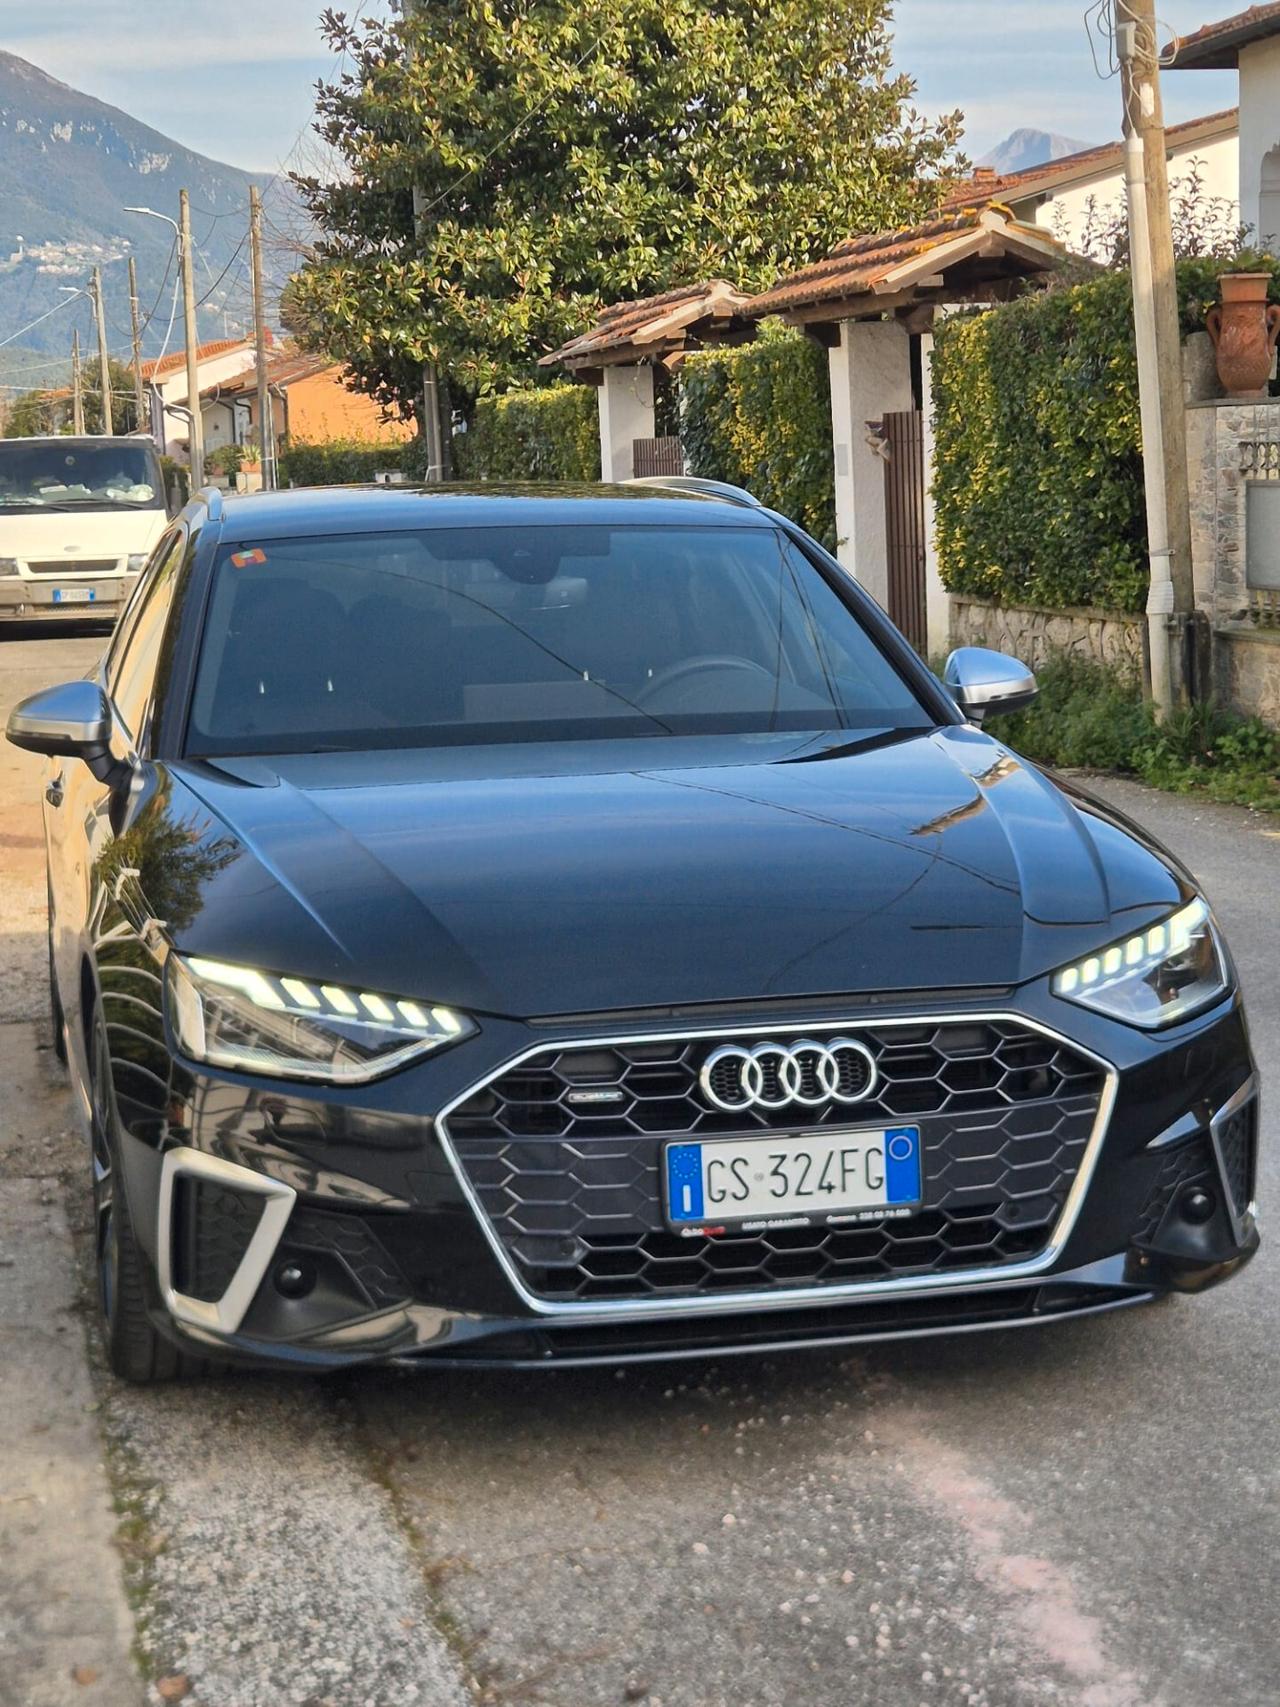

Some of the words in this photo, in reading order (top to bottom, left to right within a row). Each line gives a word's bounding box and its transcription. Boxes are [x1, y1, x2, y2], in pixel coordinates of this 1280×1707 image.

[707, 1157, 750, 1204] GS
[768, 1147, 885, 1198] 324FG
[682, 1184, 692, 1213] I
